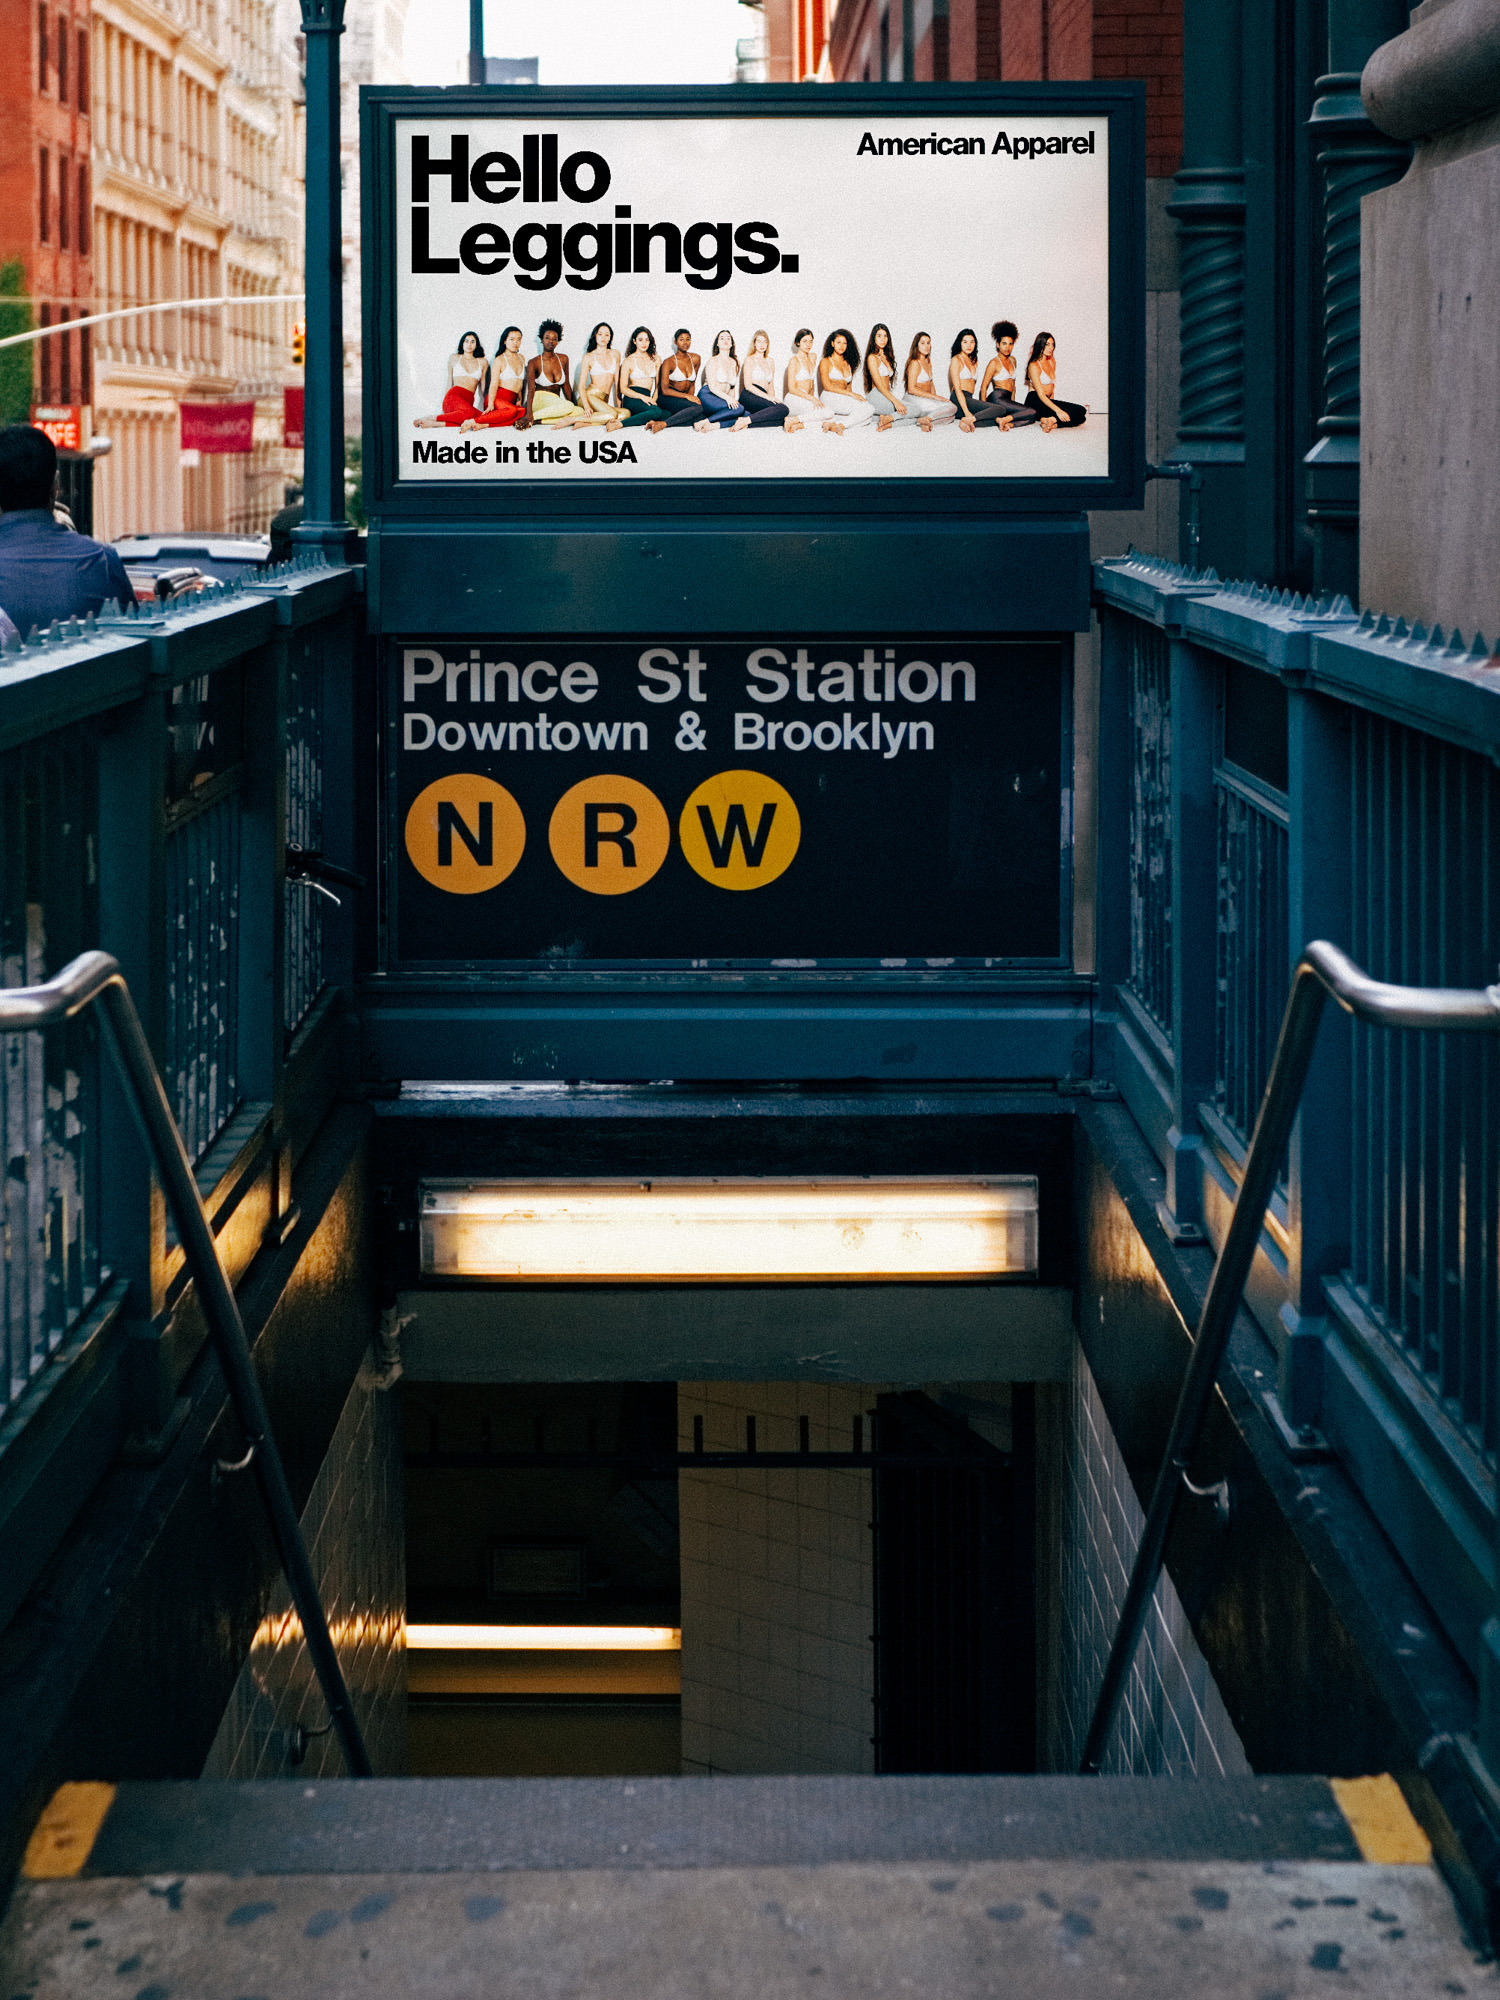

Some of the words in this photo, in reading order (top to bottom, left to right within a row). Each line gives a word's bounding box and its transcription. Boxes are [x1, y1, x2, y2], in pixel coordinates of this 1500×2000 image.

[412, 133, 611, 203] Hello
[857, 131, 985, 156] American
[992, 130, 1094, 160] Apparel
[412, 204, 799, 291] Leggings.
[413, 441, 488, 465] Made
[496, 440, 519, 464] in
[526, 441, 571, 465] the
[579, 441, 638, 465] USA
[403, 650, 599, 703] Prince
[637, 648, 707, 704] St
[745, 648, 977, 704] Station
[403, 712, 648, 752] Downtown
[675, 710, 707, 752] &
[734, 712, 935, 759] Brooklyn
[437, 801, 494, 868] N
[584, 802, 639, 868] R
[696, 802, 778, 869] W
